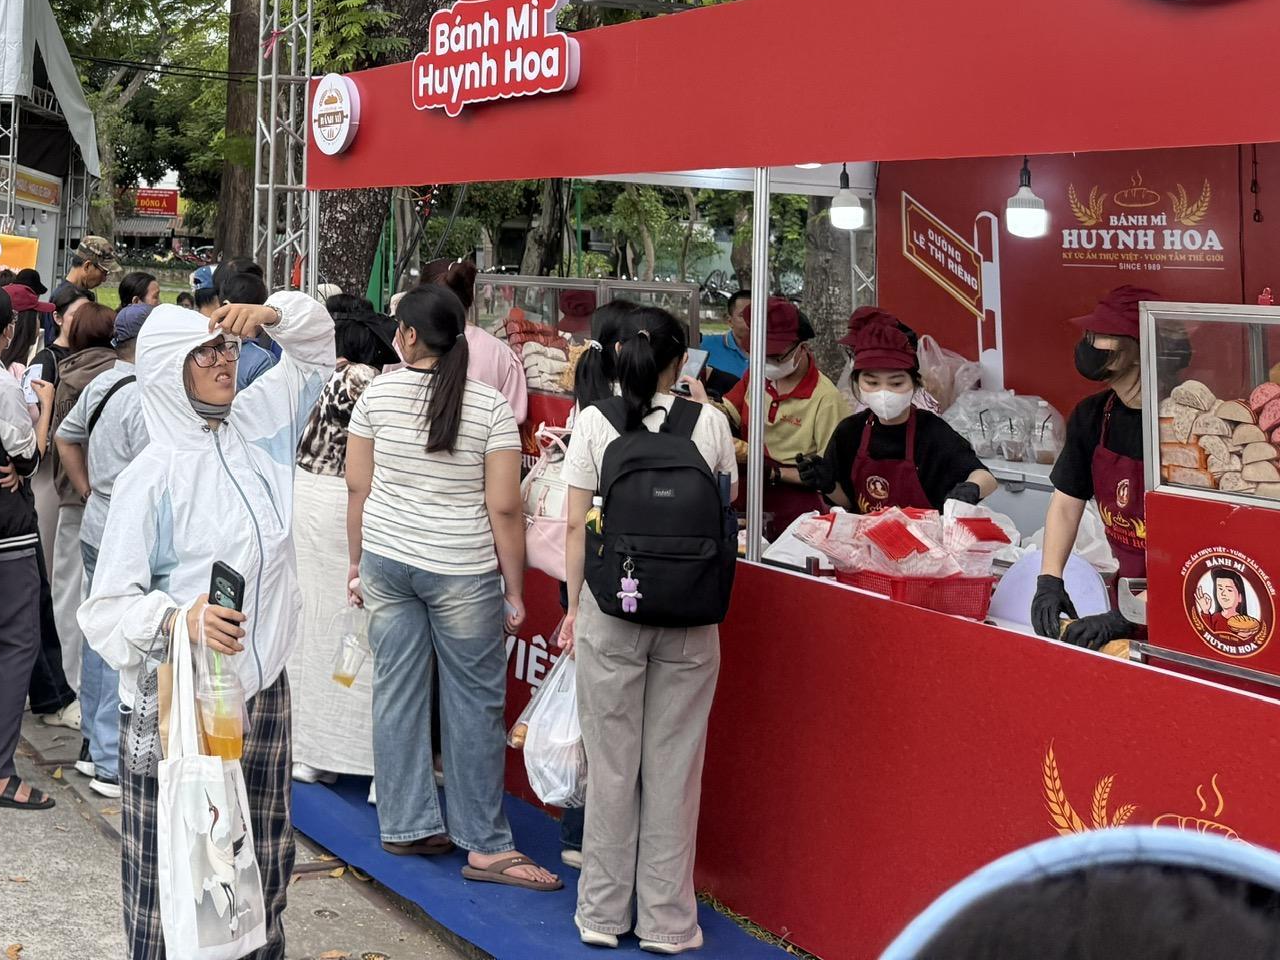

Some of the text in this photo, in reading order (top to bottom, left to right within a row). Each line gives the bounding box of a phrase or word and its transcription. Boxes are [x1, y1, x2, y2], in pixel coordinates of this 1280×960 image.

[435, 11, 499, 56] Bánh
[418, 46, 560, 104] Huynh Hoa
[1109, 211, 1167, 226] BÁNH MÌ
[1061, 229, 1224, 251] HUYNH HOA
[1118, 263, 1141, 271] SINCE
[1205, 556, 1232, 568] BÁNH
[1203, 631, 1237, 654] HUYNH
[1238, 642, 1258, 655] HOA
